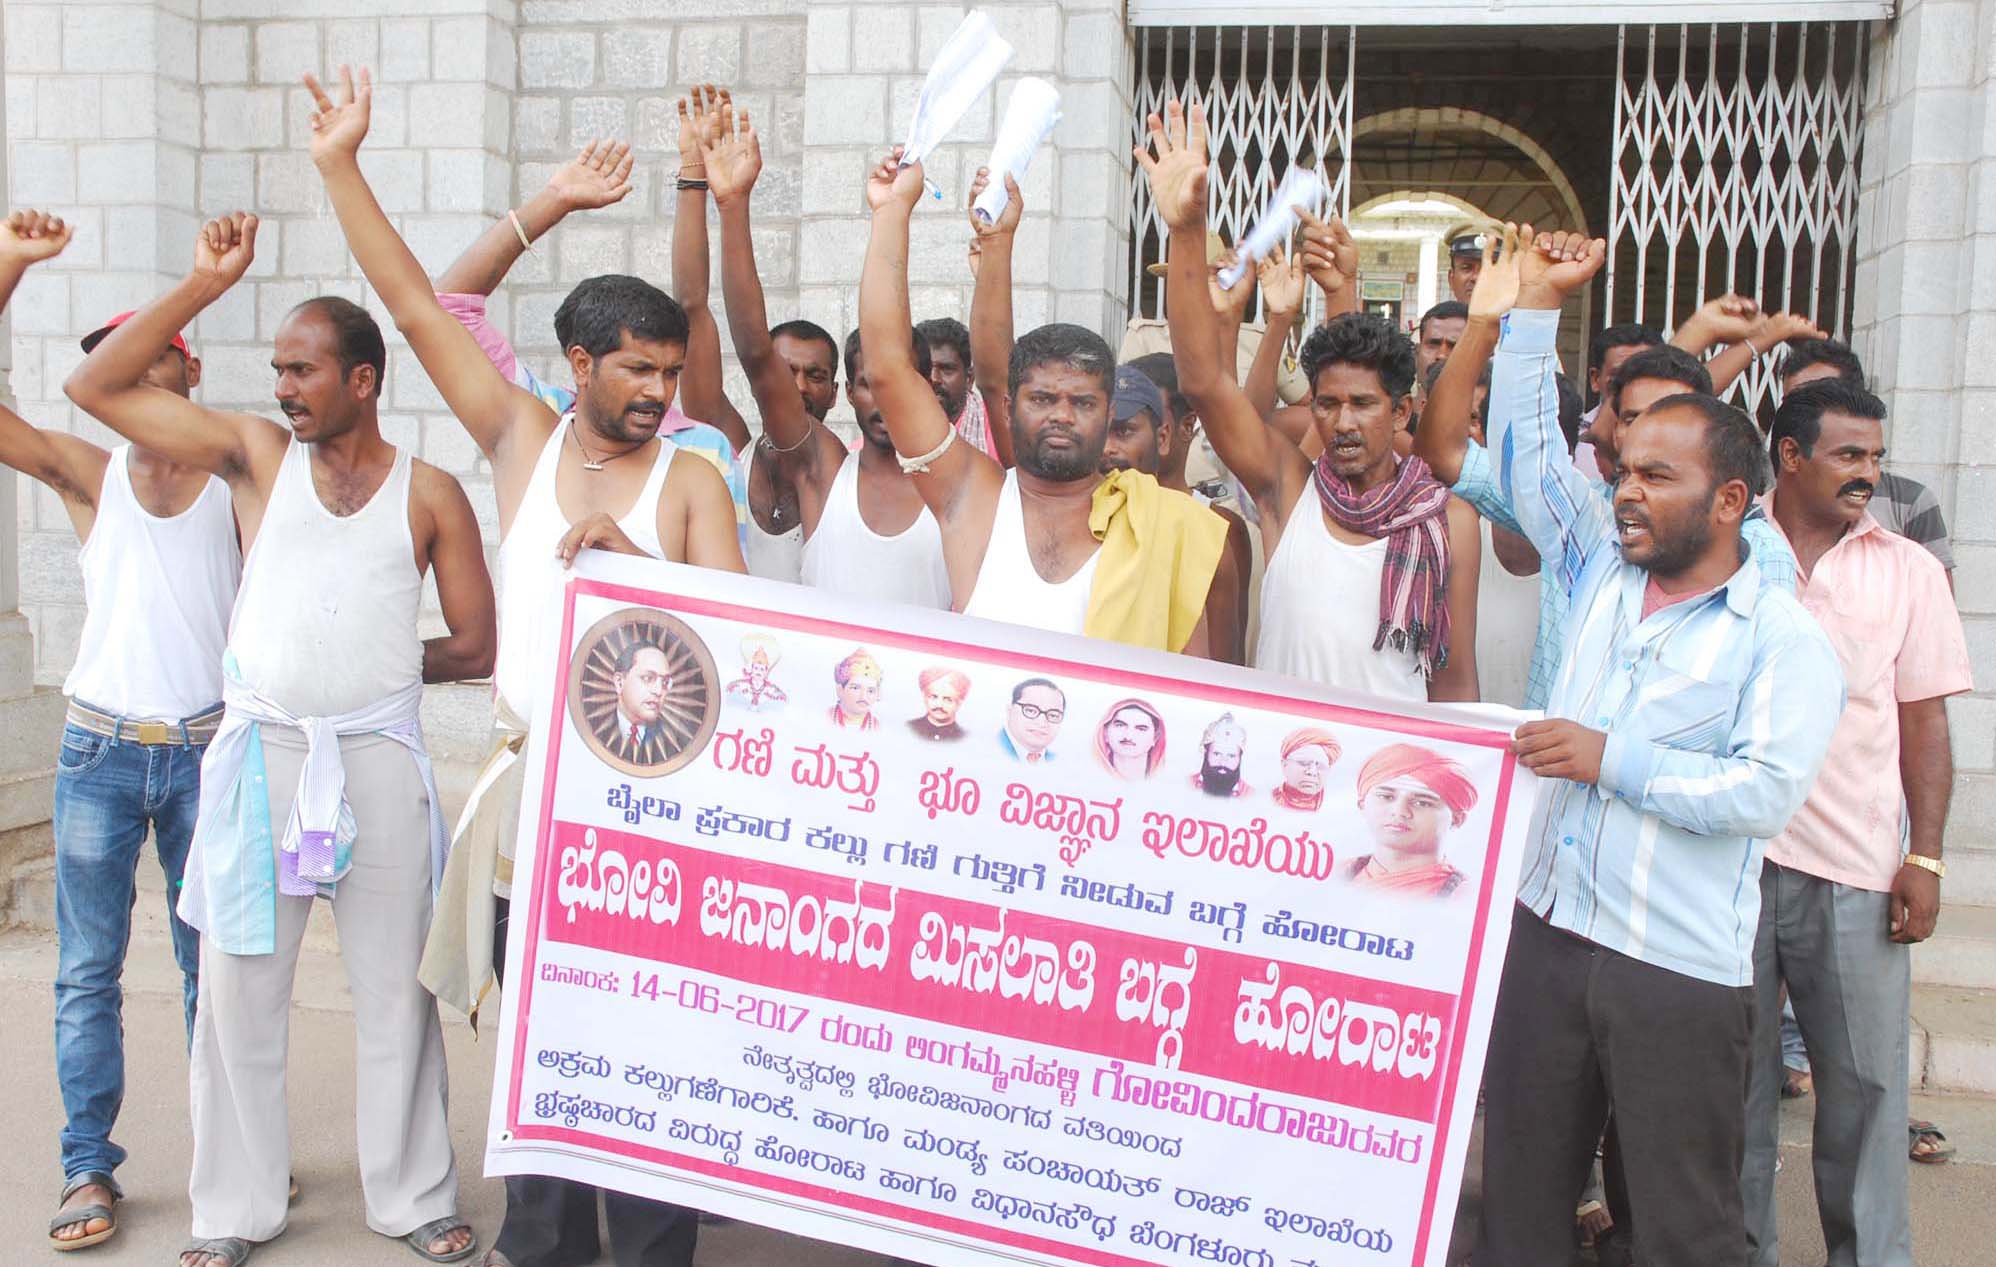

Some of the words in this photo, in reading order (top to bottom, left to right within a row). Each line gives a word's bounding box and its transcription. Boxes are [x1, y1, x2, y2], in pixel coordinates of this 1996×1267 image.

[607, 784, 681, 825] ಬೈಲಾ
[696, 805, 791, 842] ಪ್ರಕಾರ
[806, 826, 867, 865] ಕಲ್ಲು
[883, 840, 938, 870] ಗಣಿ
[953, 854, 1046, 894] ಗುತ್ತಿಗೆ
[1060, 875, 1174, 915] ನೀಡುವ
[1189, 901, 1247, 943] ಬಗ್ಗೆ
[1262, 910, 1414, 960] ಹೋರಾಟ
[713, 728, 775, 777] ಗಣಿ
[791, 744, 880, 813] ಮತ್ತು
[918, 767, 980, 820] ಭೂ
[1000, 783, 1124, 868] ವಿಜ್ಞಾನ
[1142, 811, 1334, 881] ಇಲಾಖೆಯು
[557, 828, 682, 926] ಭೋವಿ
[700, 879, 899, 971] ಜನಾಂಗದ
[1116, 946, 1198, 1070] ಬಗ್ಗೆ
[1233, 961, 1441, 1081] ಹೋರಾಟ
[537, 1050, 611, 1078] ಅಕ್ರಮ
[813, 1109, 889, 1142] ಹಾಗೂ
[904, 1129, 988, 1176] ಮಂಡ್ಯ
[1003, 1150, 1159, 1197] ಪಂಚಾಯತ್
[1174, 1187, 1249, 1217] ರಾಜ್
[1264, 1208, 1393, 1253] ಇಲಾಖೆಯ
[631, 971, 810, 1033] 14-06-2017
[820, 1014, 893, 1054] ರಂದು
[1092, 1060, 1423, 1164] ಗೋವಿಂದರಾಜುರವರ
[868, 1073, 1052, 1130] ಭೋವಿಜನಾಂಗದ
[1064, 1117, 1183, 1158] ವತಿಯಿಂದ
[755, 1136, 866, 1181] ಹೋರಾಟ
[879, 1168, 957, 1202] ಹಾಗೂ
[971, 1189, 1117, 1242] ವಿಧಾನಸೌಧ
[1129, 1221, 1274, 1267] ಬೆಂಗಳೂರು
